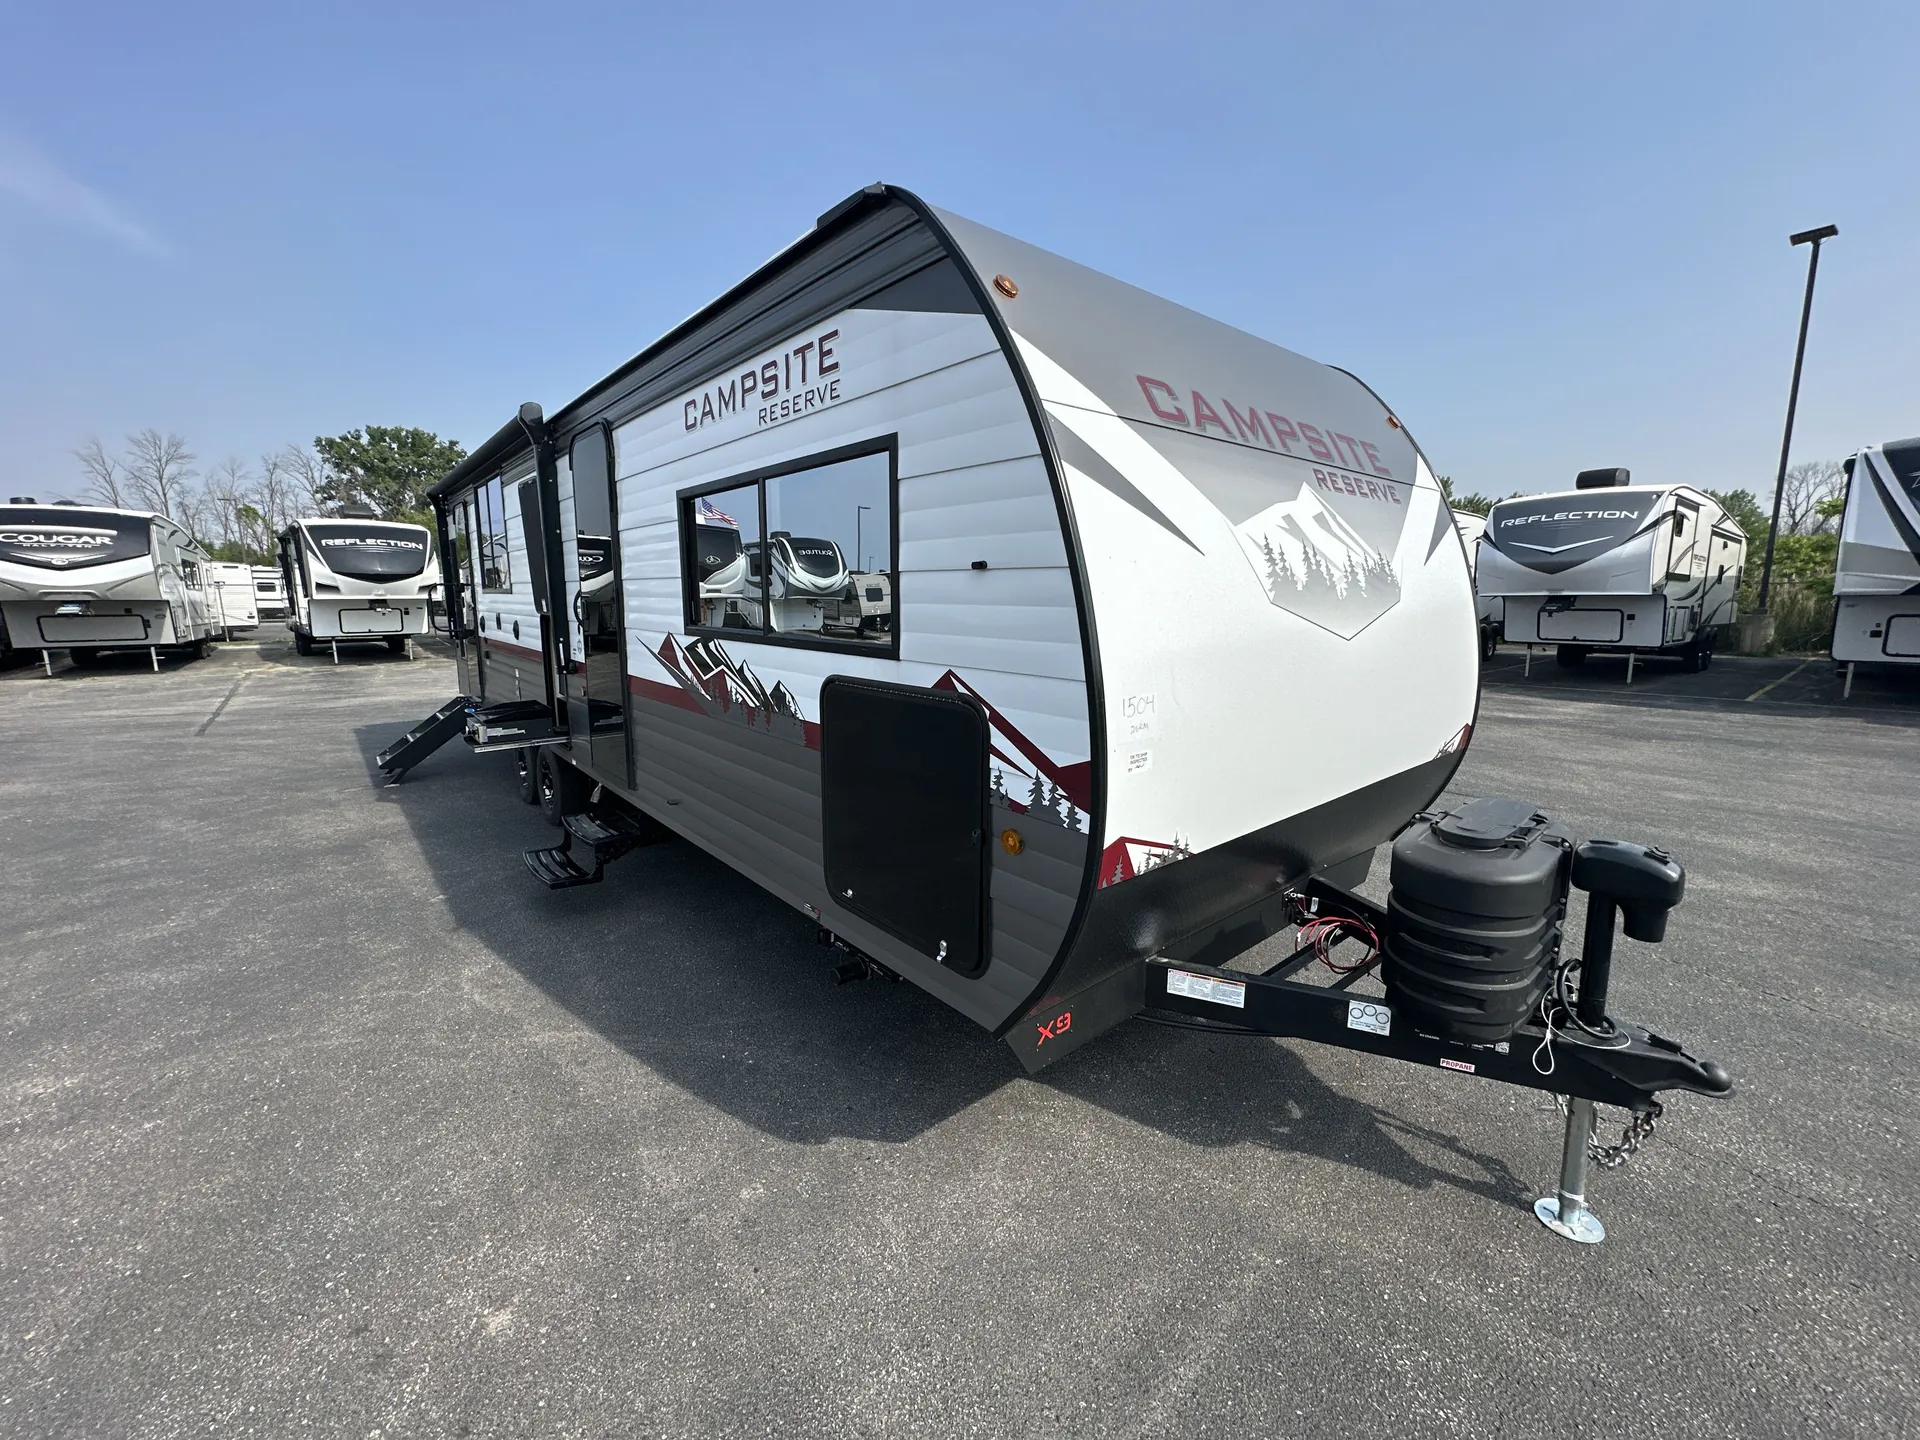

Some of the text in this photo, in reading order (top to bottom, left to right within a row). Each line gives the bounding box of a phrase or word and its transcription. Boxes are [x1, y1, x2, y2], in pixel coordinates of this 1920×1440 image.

[684, 329, 841, 432] CAMPSITE
[758, 379, 842, 427] RESERVE
[1136, 374, 1394, 478] CAMPSITE
[1312, 468, 1402, 505] RESERVE
[1500, 510, 1639, 528] REFLECTION
[0, 533, 114, 545] COUGAR
[320, 538, 424, 550] REFLECTION
[1123, 694, 1155, 718] 1504
[1037, 1012, 1071, 1046] X9
[1441, 1060, 1473, 1071] PROPANE
